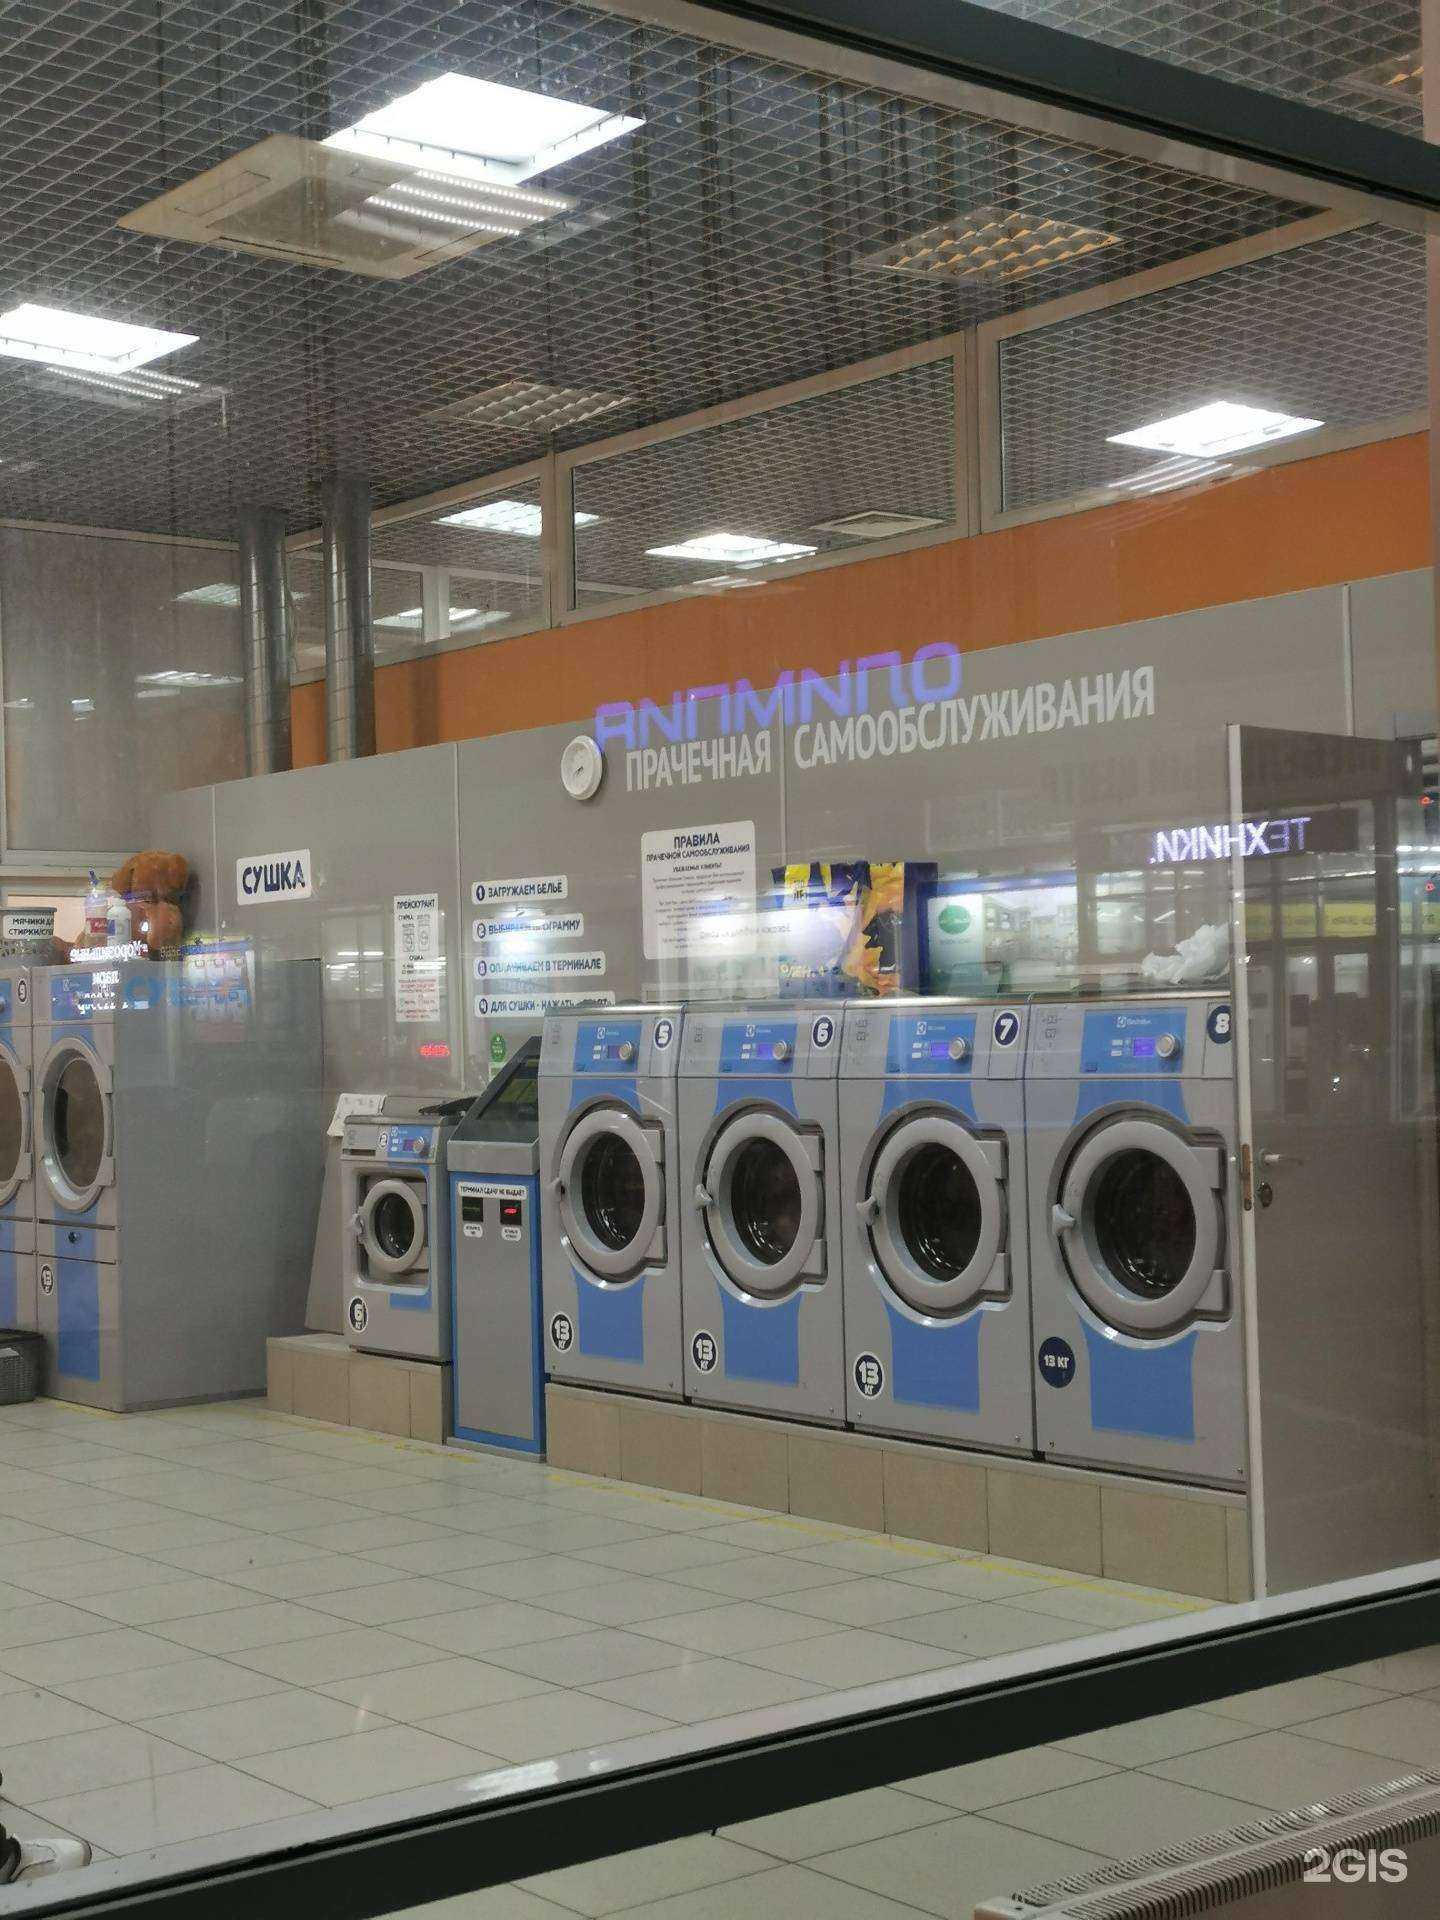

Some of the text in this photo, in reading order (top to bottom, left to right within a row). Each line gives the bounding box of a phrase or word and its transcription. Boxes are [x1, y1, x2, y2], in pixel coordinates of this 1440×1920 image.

[625, 665, 1155, 792] ПРАЧЕЧНАЯ САМООБСЛУЖИВАНИЯ
[673, 832, 720, 849] ПРАВИЛА
[646, 843, 750, 862] ПРАЧЕЧНОЙ САМООБСЛУЖИВАНИЯ
[242, 860, 306, 895] СУШКА
[488, 884, 536, 898] ЗАГРУЖАЕМ
[537, 880, 562, 894] БЕЛЬЁ
[12, 918, 45, 926] МЯЧИКИ
[488, 922, 532, 935] ВЫБИР
[531, 919, 581, 931] ОГРАММУ
[553, 958, 602, 971] ТЕРМИНАЛЕ
[490, 1000, 507, 1013] ДЛЯ
[508, 998, 535, 1011] СУШКИ
[1215, 1013, 1230, 1034] 8
[554, 1319, 570, 1341] 13
[695, 1338, 713, 1362] 13
[858, 1361, 879, 1385] 13
